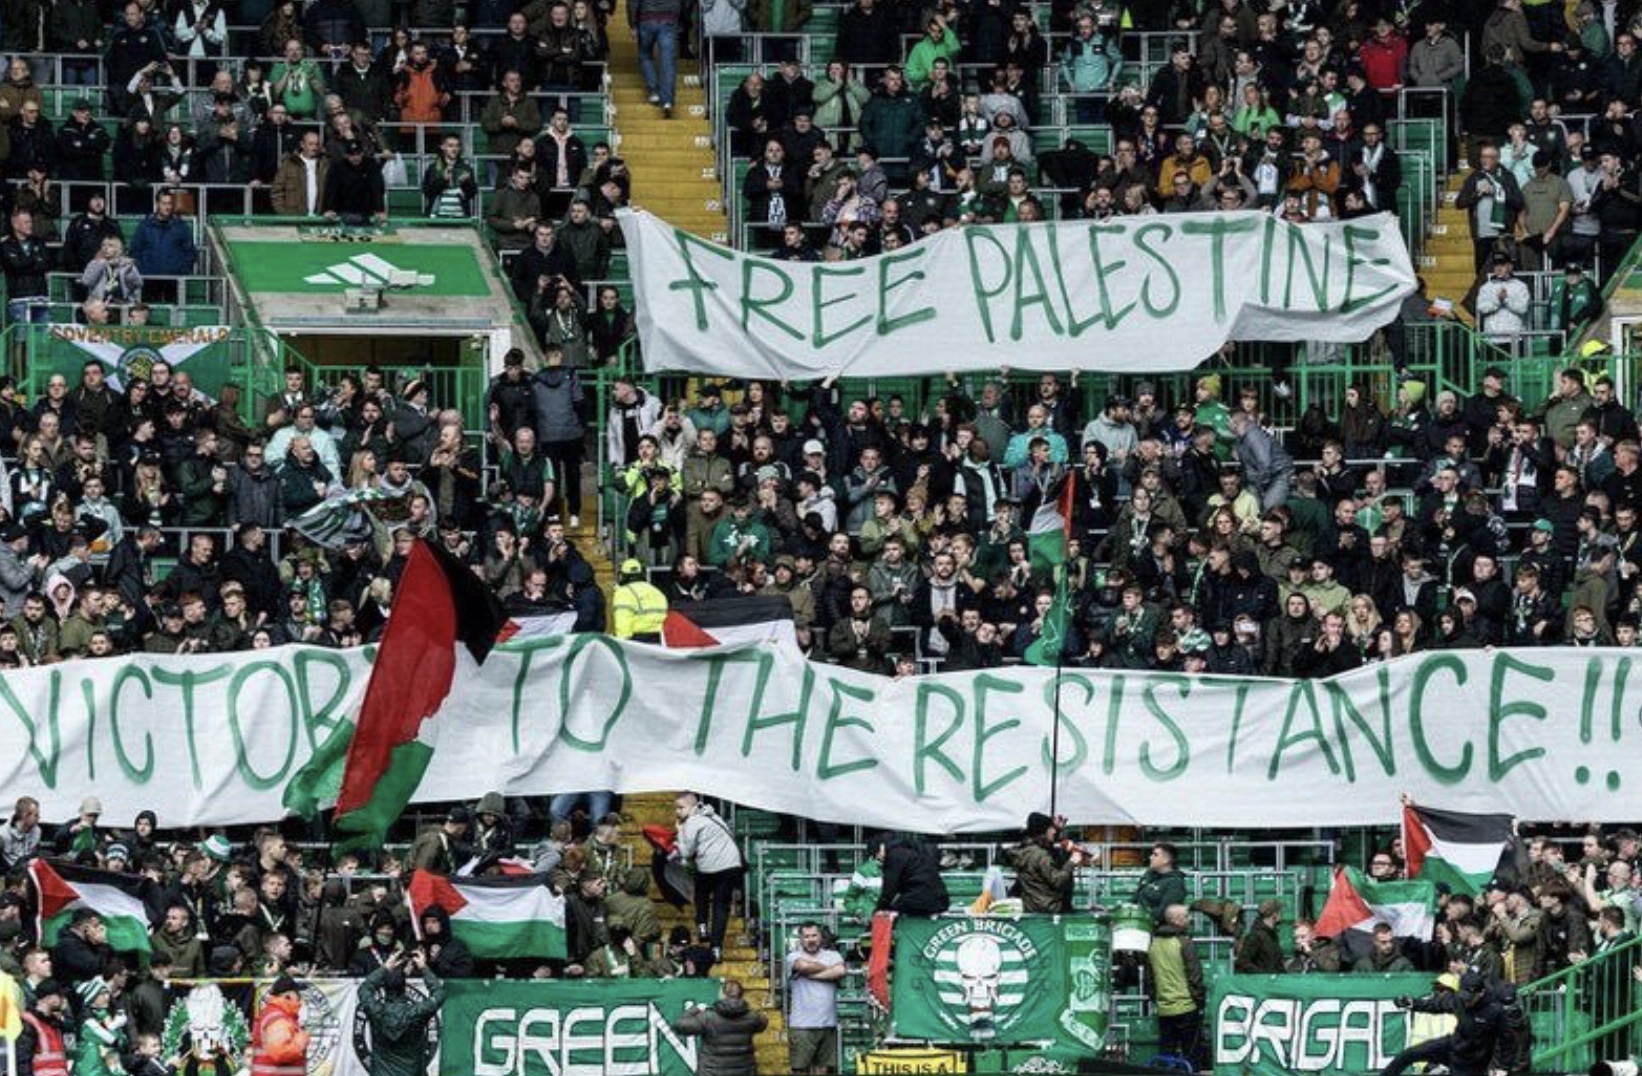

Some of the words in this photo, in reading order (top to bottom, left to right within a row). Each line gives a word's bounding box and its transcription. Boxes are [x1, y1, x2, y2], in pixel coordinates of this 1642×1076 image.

[669, 227, 937, 348] FREE
[964, 215, 1400, 344] PALESTINE
[0, 646, 377, 790] VICTOR
[495, 633, 633, 755] TO
[686, 648, 879, 780] THE
[913, 653, 1632, 802] RESISTANCE!!
[923, 921, 968, 960] GREEN
[974, 919, 1037, 960] BRIGADE
[474, 1001, 698, 1075] GREEN
[1217, 994, 1412, 1070] BRIGAD
[873, 1062, 912, 1075] THIS
[917, 1062, 931, 1075] IS
[938, 1062, 948, 1075] A
